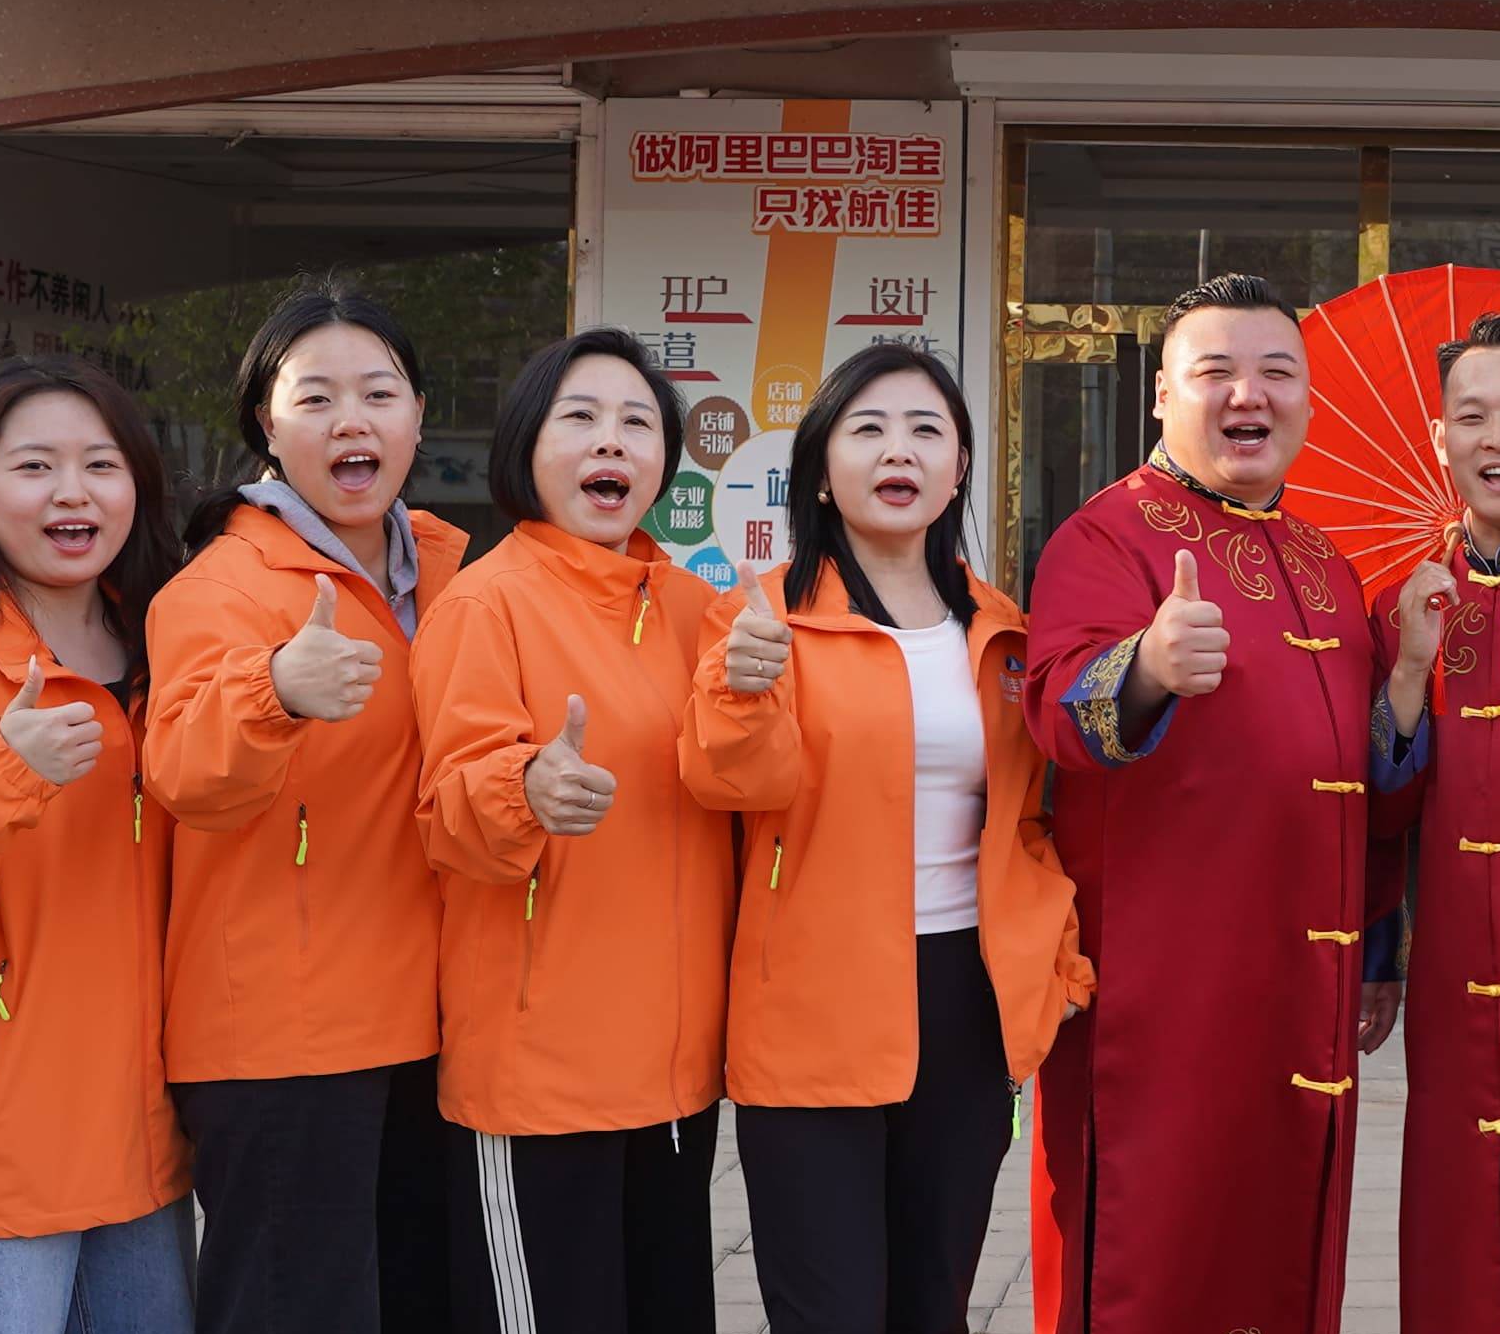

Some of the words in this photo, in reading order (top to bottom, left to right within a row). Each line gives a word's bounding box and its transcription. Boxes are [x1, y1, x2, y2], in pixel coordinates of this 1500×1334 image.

[633, 132, 943, 178] 做阿里巴巴淘宝
[756, 187, 939, 231] 只找航佳
[660, 275, 728, 313] 开户
[869, 277, 938, 316] 设计
[699, 411, 735, 432] 店铺
[699, 435, 735, 455] 引流
[670, 486, 705, 508] 专业
[670, 509, 705, 530] 摄影
[696, 562, 732, 582] 电商
